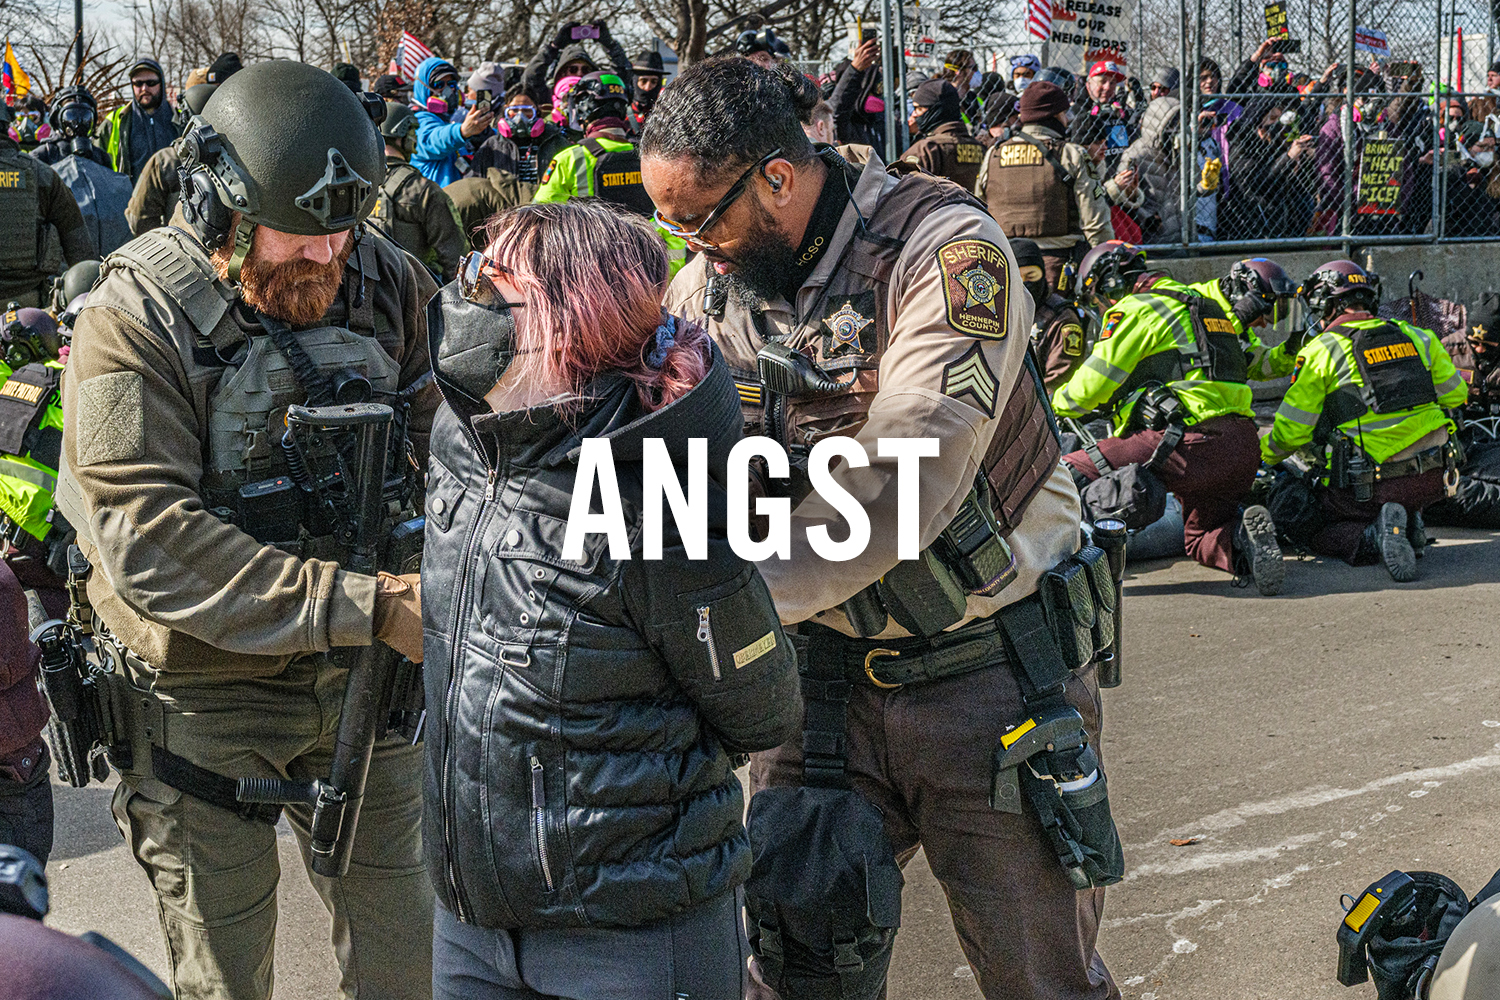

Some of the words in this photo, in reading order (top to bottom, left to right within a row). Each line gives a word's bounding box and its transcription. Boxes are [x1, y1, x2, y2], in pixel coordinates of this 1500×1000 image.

[1066, 0, 1121, 17] RELEASE
[1078, 18, 1106, 33] OUR
[1052, 31, 1127, 53] NEIGHBORS
[1000, 144, 1043, 167] SHERIFF
[1365, 143, 1394, 154] BRING
[1370, 156, 1403, 172] HEAT
[0, 171, 20, 188] RIFF
[603, 173, 625, 187] STATE
[625, 171, 643, 184] PATR
[1360, 173, 1390, 185] MELT
[1367, 186, 1400, 204] ICE!
[796, 236, 824, 266] HCSO
[944, 245, 1005, 269] SHERIFF
[959, 313, 1000, 329] HENNEPIN
[961, 320, 999, 333] COUNTY
[1363, 346, 1392, 365] STATE
[1388, 342, 1418, 359] PATROL
[13, 382, 43, 404] PATROL
